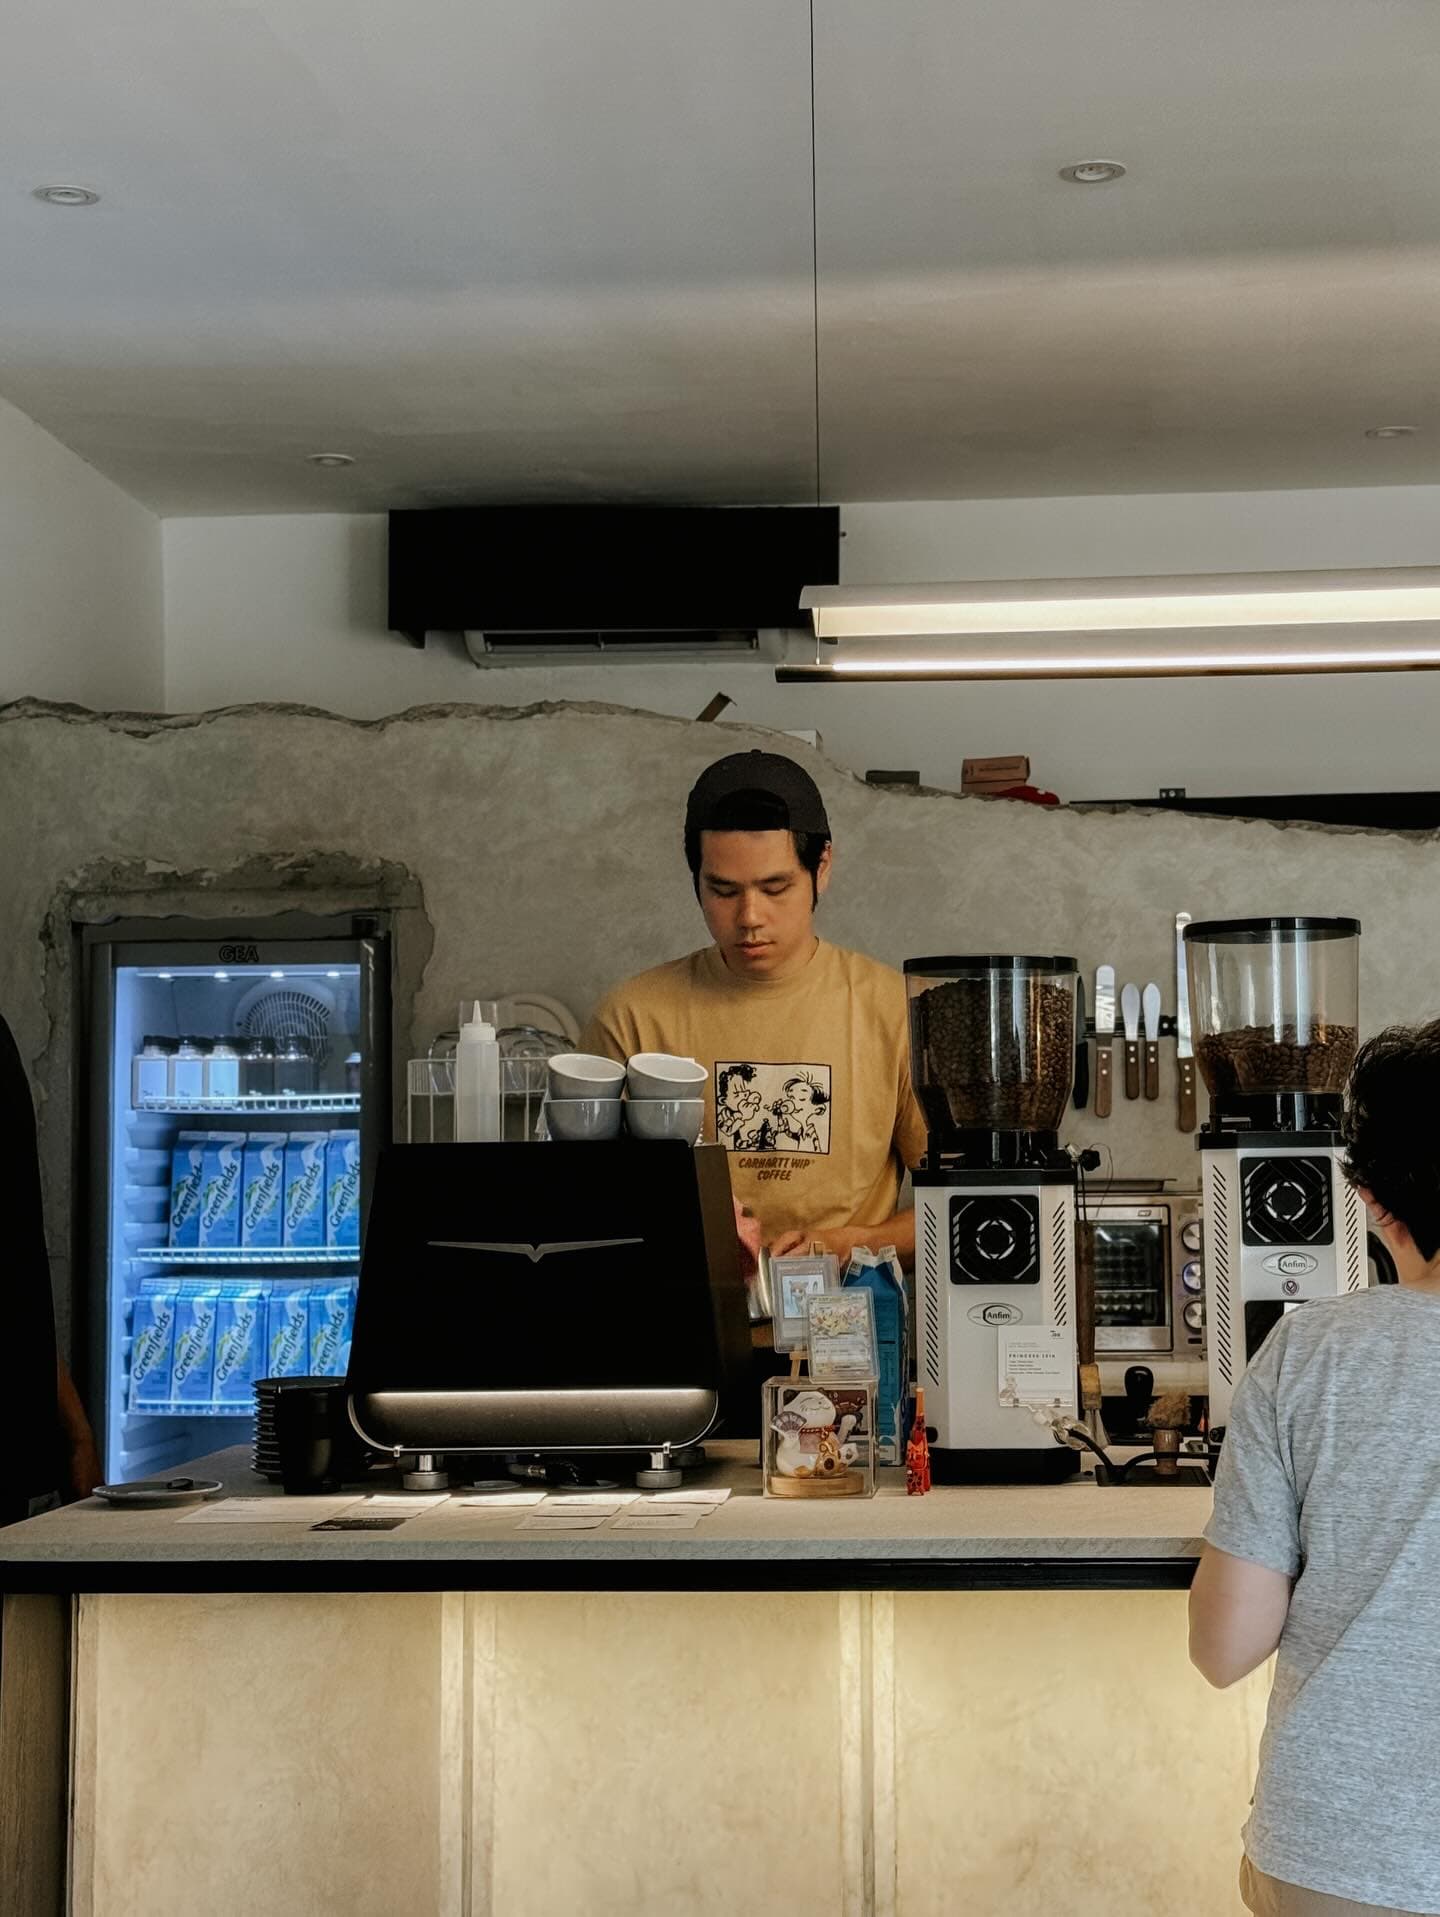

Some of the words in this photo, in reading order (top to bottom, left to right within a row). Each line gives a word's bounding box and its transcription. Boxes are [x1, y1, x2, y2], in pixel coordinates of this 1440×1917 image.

[219, 945, 259, 962] GEA
[172, 1162, 202, 1228] Greenfield
[202, 1162, 238, 1229] Greenfields
[245, 1162, 280, 1229] Greenfields
[287, 1162, 321, 1229] Greenfields
[738, 1157, 790, 1168] CARHARTT
[791, 1158, 811, 1170] WIP
[757, 1169, 792, 1181] COFFEE
[1282, 1260, 1306, 1268] Anfim
[133, 1311, 171, 1381] Greenfields
[174, 1312, 212, 1381] Greenfields
[215, 1312, 253, 1382] Greenfields
[987, 1311, 1010, 1319] Anfim
